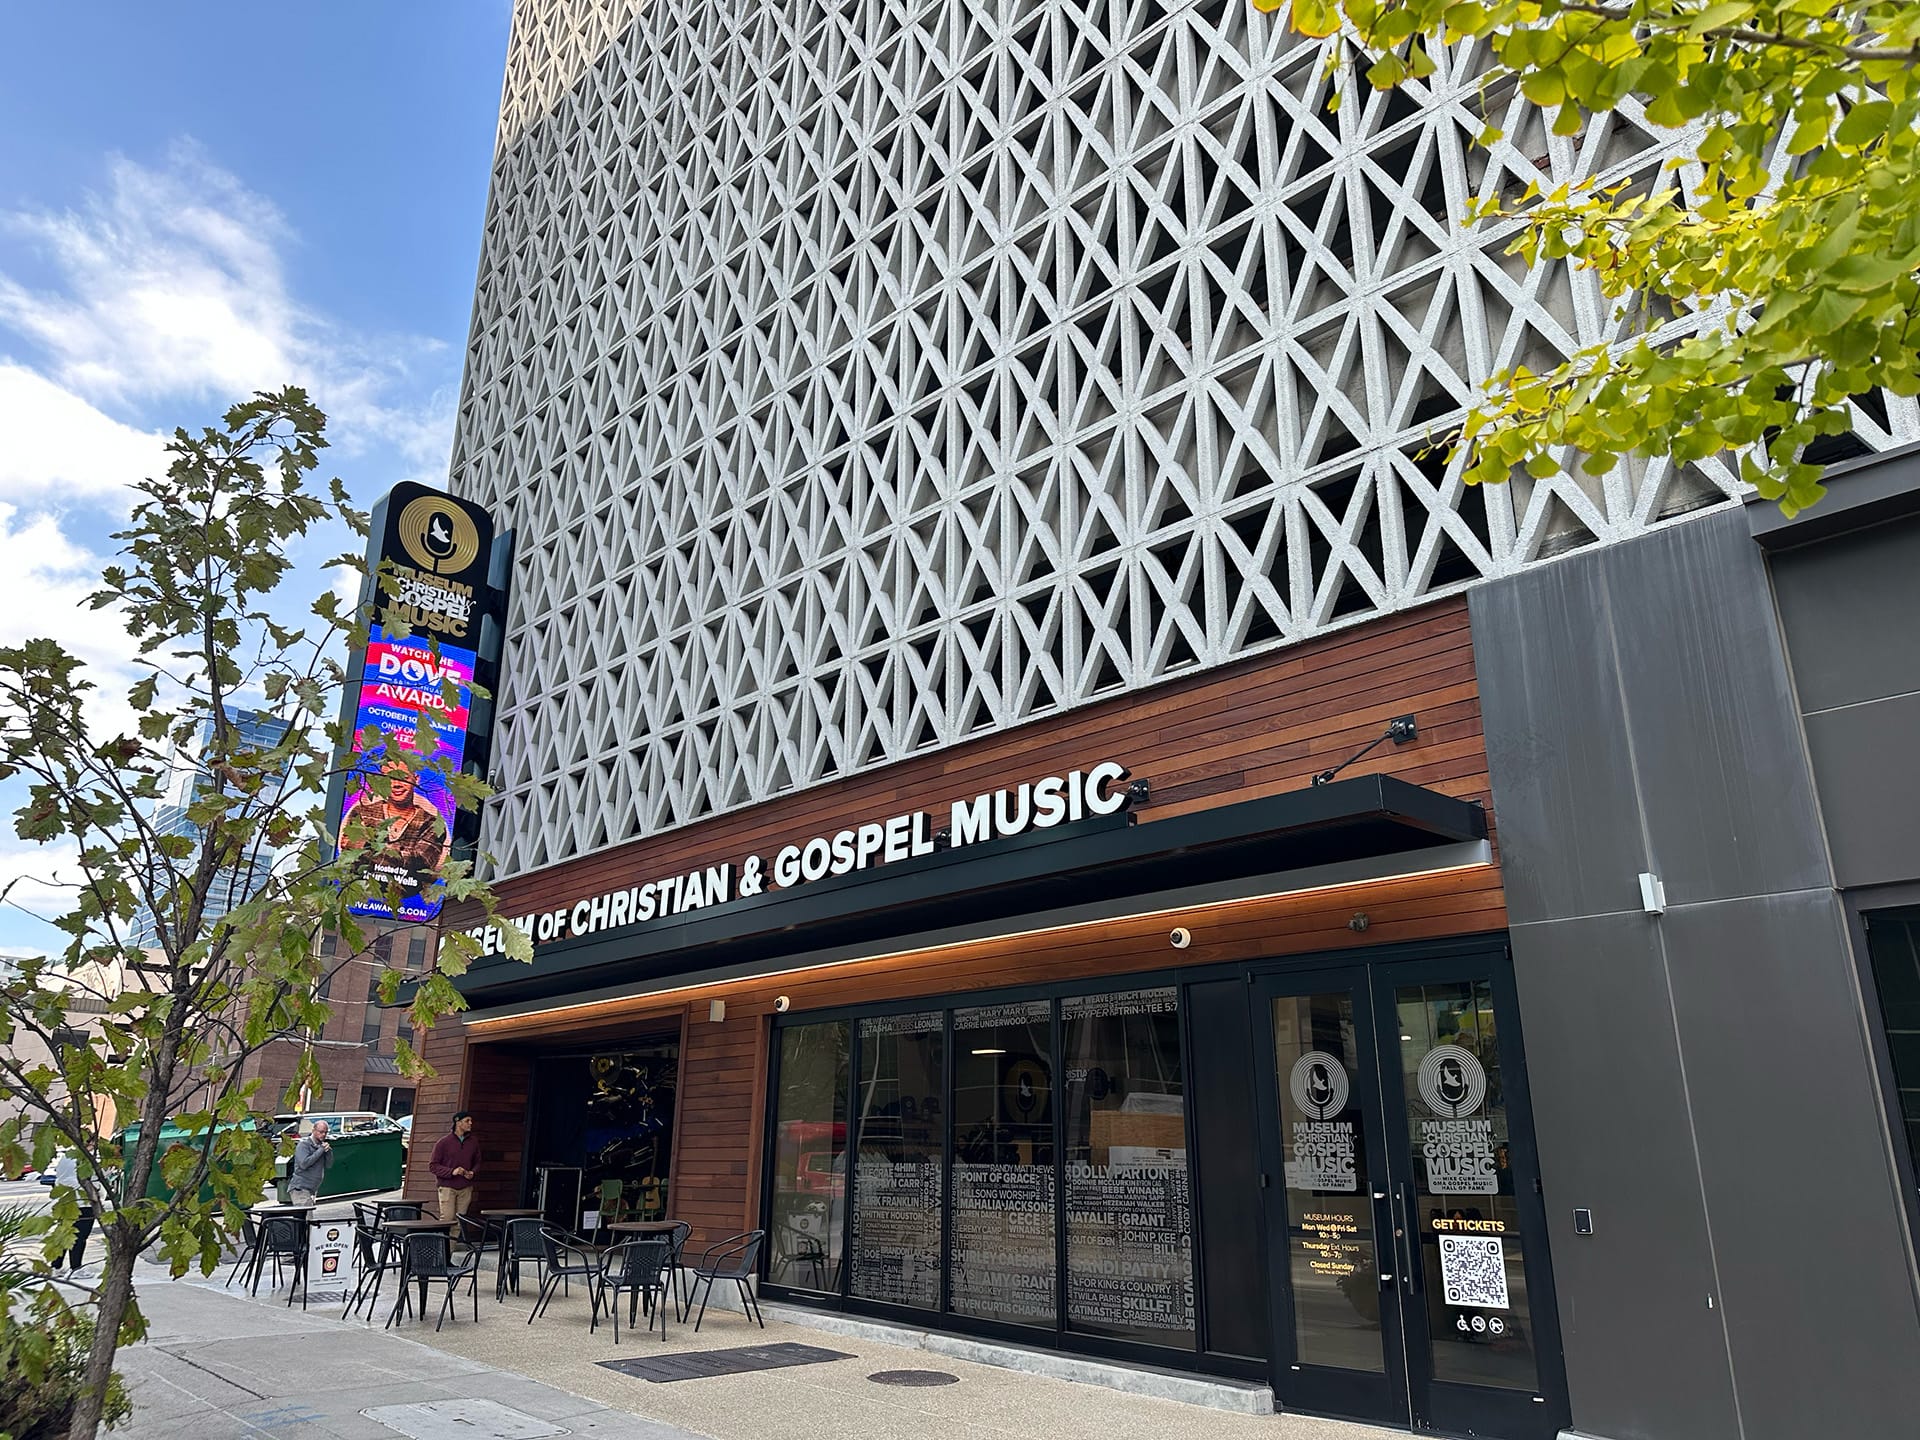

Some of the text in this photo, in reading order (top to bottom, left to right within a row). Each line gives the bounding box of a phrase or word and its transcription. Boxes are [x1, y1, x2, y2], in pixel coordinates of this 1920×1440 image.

[397, 577, 466, 605] CHRISTIAN
[388, 600, 468, 637] MUSIC
[391, 644, 454, 667] WATCH HE
[379, 652, 461, 686] DOVE
[376, 683, 456, 712] AWARD
[367, 707, 407, 721] OCTOBER
[381, 722, 416, 735] ONLY ON
[437, 762, 1127, 961] SEUM OF CHRISTIAN & GOSPEL MUSIC
[374, 864, 408, 876] Hosted by
[394, 874, 418, 887] Wells
[980, 1008, 1001, 1018] MARY
[1003, 1006, 1026, 1016] MARY
[1066, 1009, 1109, 1021] STRYPER
[1120, 1003, 1163, 1016] TRIN-I-TEE
[1164, 1001, 1178, 1012] 5:7
[868, 1023, 893, 1033] TASHA
[953, 1016, 1025, 1031] CARRIE UNDERWOOD
[1293, 1122, 1353, 1133] MUSEUM
[1422, 1120, 1491, 1133] MUSEUM
[1297, 1133, 1349, 1143] CHRISTIAN
[1427, 1133, 1488, 1143] CHRISTIAN
[1293, 1143, 1354, 1157] GOSPEL
[1423, 1142, 1495, 1158] GOSPEL
[894, 1163, 916, 1173] 4HIM
[990, 1164, 1055, 1174] RANDY MATTHEWS
[1295, 1157, 1355, 1173] MUSIC
[1426, 1158, 1496, 1175] MUSIC
[864, 1168, 894, 1178] LECRAE
[961, 1172, 1035, 1184] POINT OF GRACE
[1072, 1165, 1170, 1180] DOLLY PARTON
[898, 1179, 920, 1188] CARR
[960, 1189, 1036, 1200] HILLSONG WORSHIP
[1065, 1183, 1073, 1210] TALK
[1102, 1186, 1125, 1194] BEBE
[1126, 1187, 1165, 1195] WINANS
[882, 1196, 920, 1207] FRANKLIN
[960, 1199, 1048, 1213] MAHALIA JACKSON
[1048, 1174, 1056, 1234] JOHNNY
[860, 1210, 890, 1219] WHITNEY
[890, 1212, 924, 1221] HOUSTON
[957, 1209, 1002, 1219] LAUREN DAIGLE
[1009, 1212, 1041, 1226] CECE
[1066, 1211, 1166, 1227] NATALIE GRANT
[1304, 1213, 1354, 1222] MUSEUM HOURS
[957, 1224, 1002, 1235] JEREMY CAMP
[1008, 1225, 1041, 1235] WINANS
[1316, 1223, 1330, 1231] Wed
[1336, 1224, 1346, 1232] Fri
[1432, 1219, 1506, 1232] GET TICKETS
[1072, 1235, 1115, 1246] OUT OF EDEN
[1123, 1230, 1149, 1242] JOHN
[1149, 1231, 1157, 1242] P.
[1158, 1232, 1177, 1243] KEE
[960, 1240, 998, 1251] THIRD DAY
[1020, 1246, 1046, 1256] TOMLIN
[1153, 1243, 1178, 1255] BILL
[1302, 1241, 1330, 1251] Thursday
[1342, 1244, 1360, 1252] Hours
[950, 1248, 997, 1265] SHIRLEY
[1000, 1252, 1046, 1269] CAESAR
[849, 1238, 859, 1294] SMOKIE
[1072, 1258, 1120, 1275] SANDI
[1121, 1261, 1171, 1279] PATTY
[1310, 1261, 1355, 1272] Closed Sunday
[951, 1267, 976, 1280] ELVIS
[983, 1271, 1011, 1288] AMY
[1012, 1274, 1057, 1290] GRANT
[1079, 1278, 1172, 1294] FOR KING & COUNTRY
[1181, 1234, 1196, 1331] CROWDER
[950, 1282, 984, 1294] DEGARMO
[988, 1286, 1002, 1296] KEY
[1011, 1291, 1024, 1300] PAT
[1025, 1292, 1051, 1302] BOONE
[1073, 1291, 1098, 1301] TWILA
[1099, 1293, 1121, 1304] PARIS
[950, 1297, 980, 1309] STEVEN
[981, 1300, 1011, 1313] CURTIS
[1012, 1303, 1057, 1319] CHAPMAN
[1122, 1296, 1173, 1313] SKILLET
[1067, 1303, 1106, 1317] KATINAS
[1106, 1307, 1121, 1318] THE
[1122, 1309, 1153, 1321] CRABB
[1154, 1312, 1185, 1325] FAMILY
